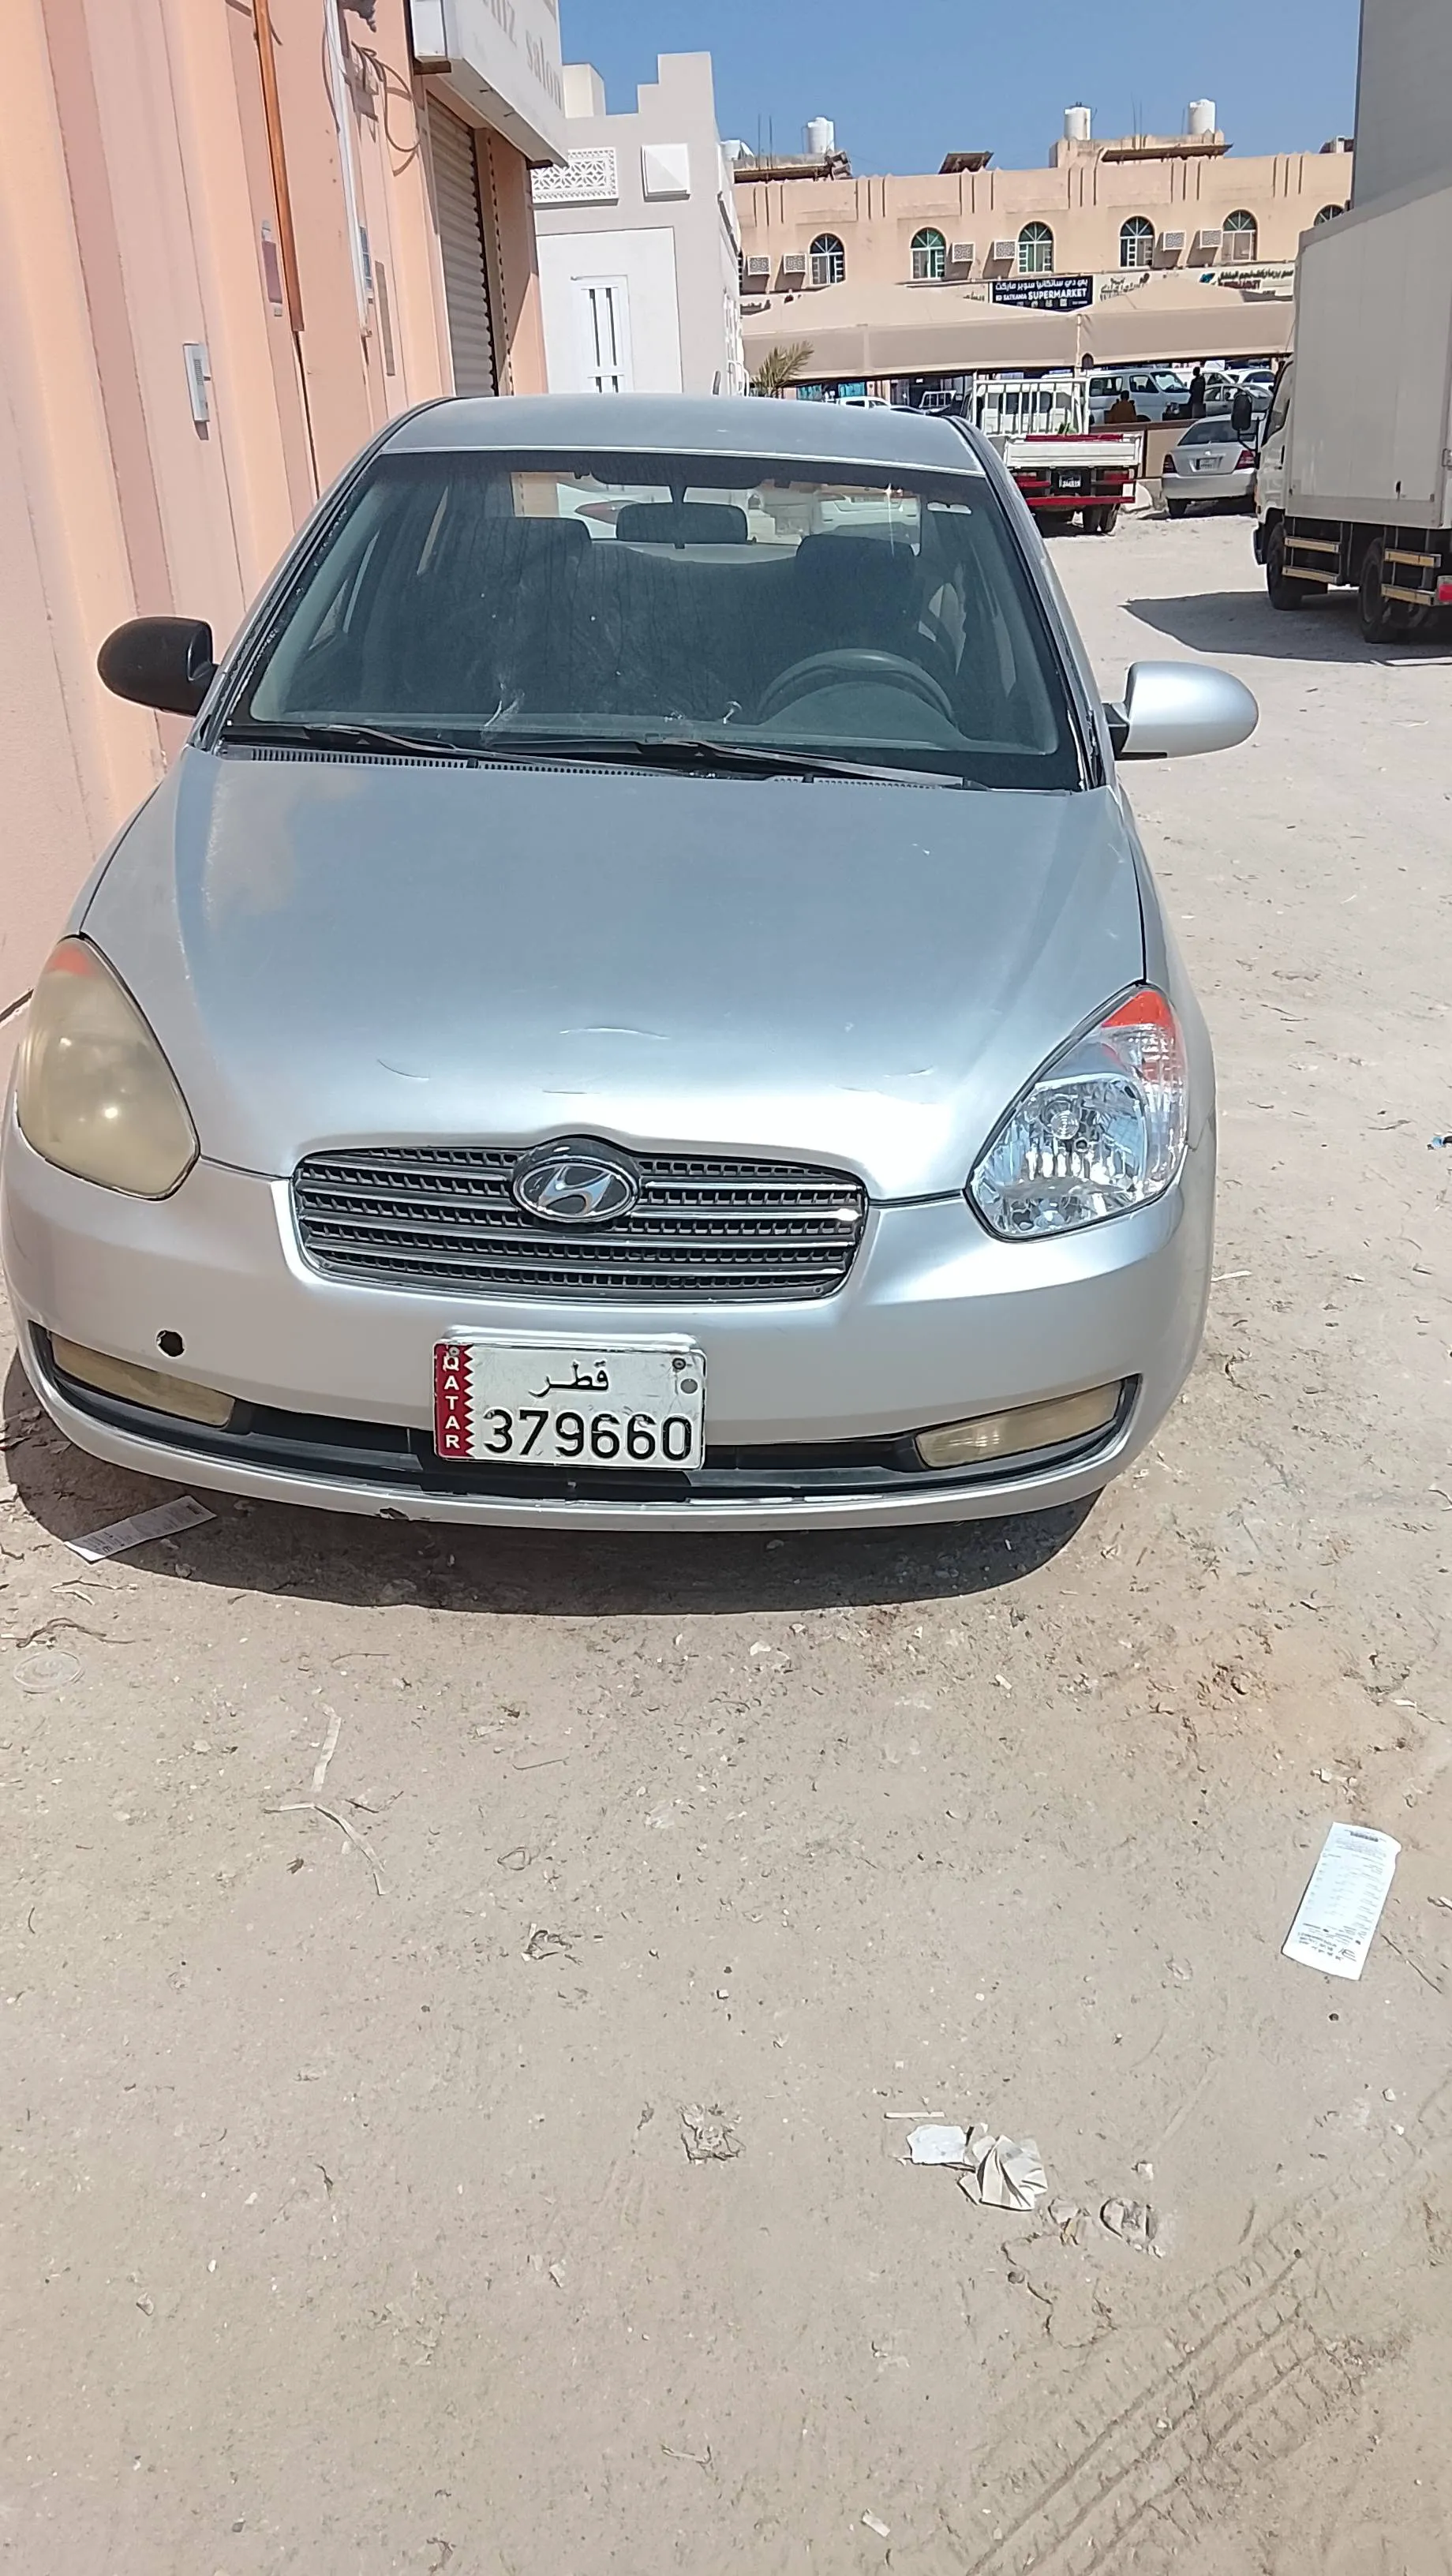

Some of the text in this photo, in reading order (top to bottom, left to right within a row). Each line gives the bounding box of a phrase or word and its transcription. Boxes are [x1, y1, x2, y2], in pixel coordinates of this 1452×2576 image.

[525, 29, 562, 110] salon
[1027, 287, 1087, 301] SUPERMARKET
[442, 1351, 462, 1450] QATAR
[529, 1359, 610, 1398] قطر
[482, 1408, 693, 1461] 379660
